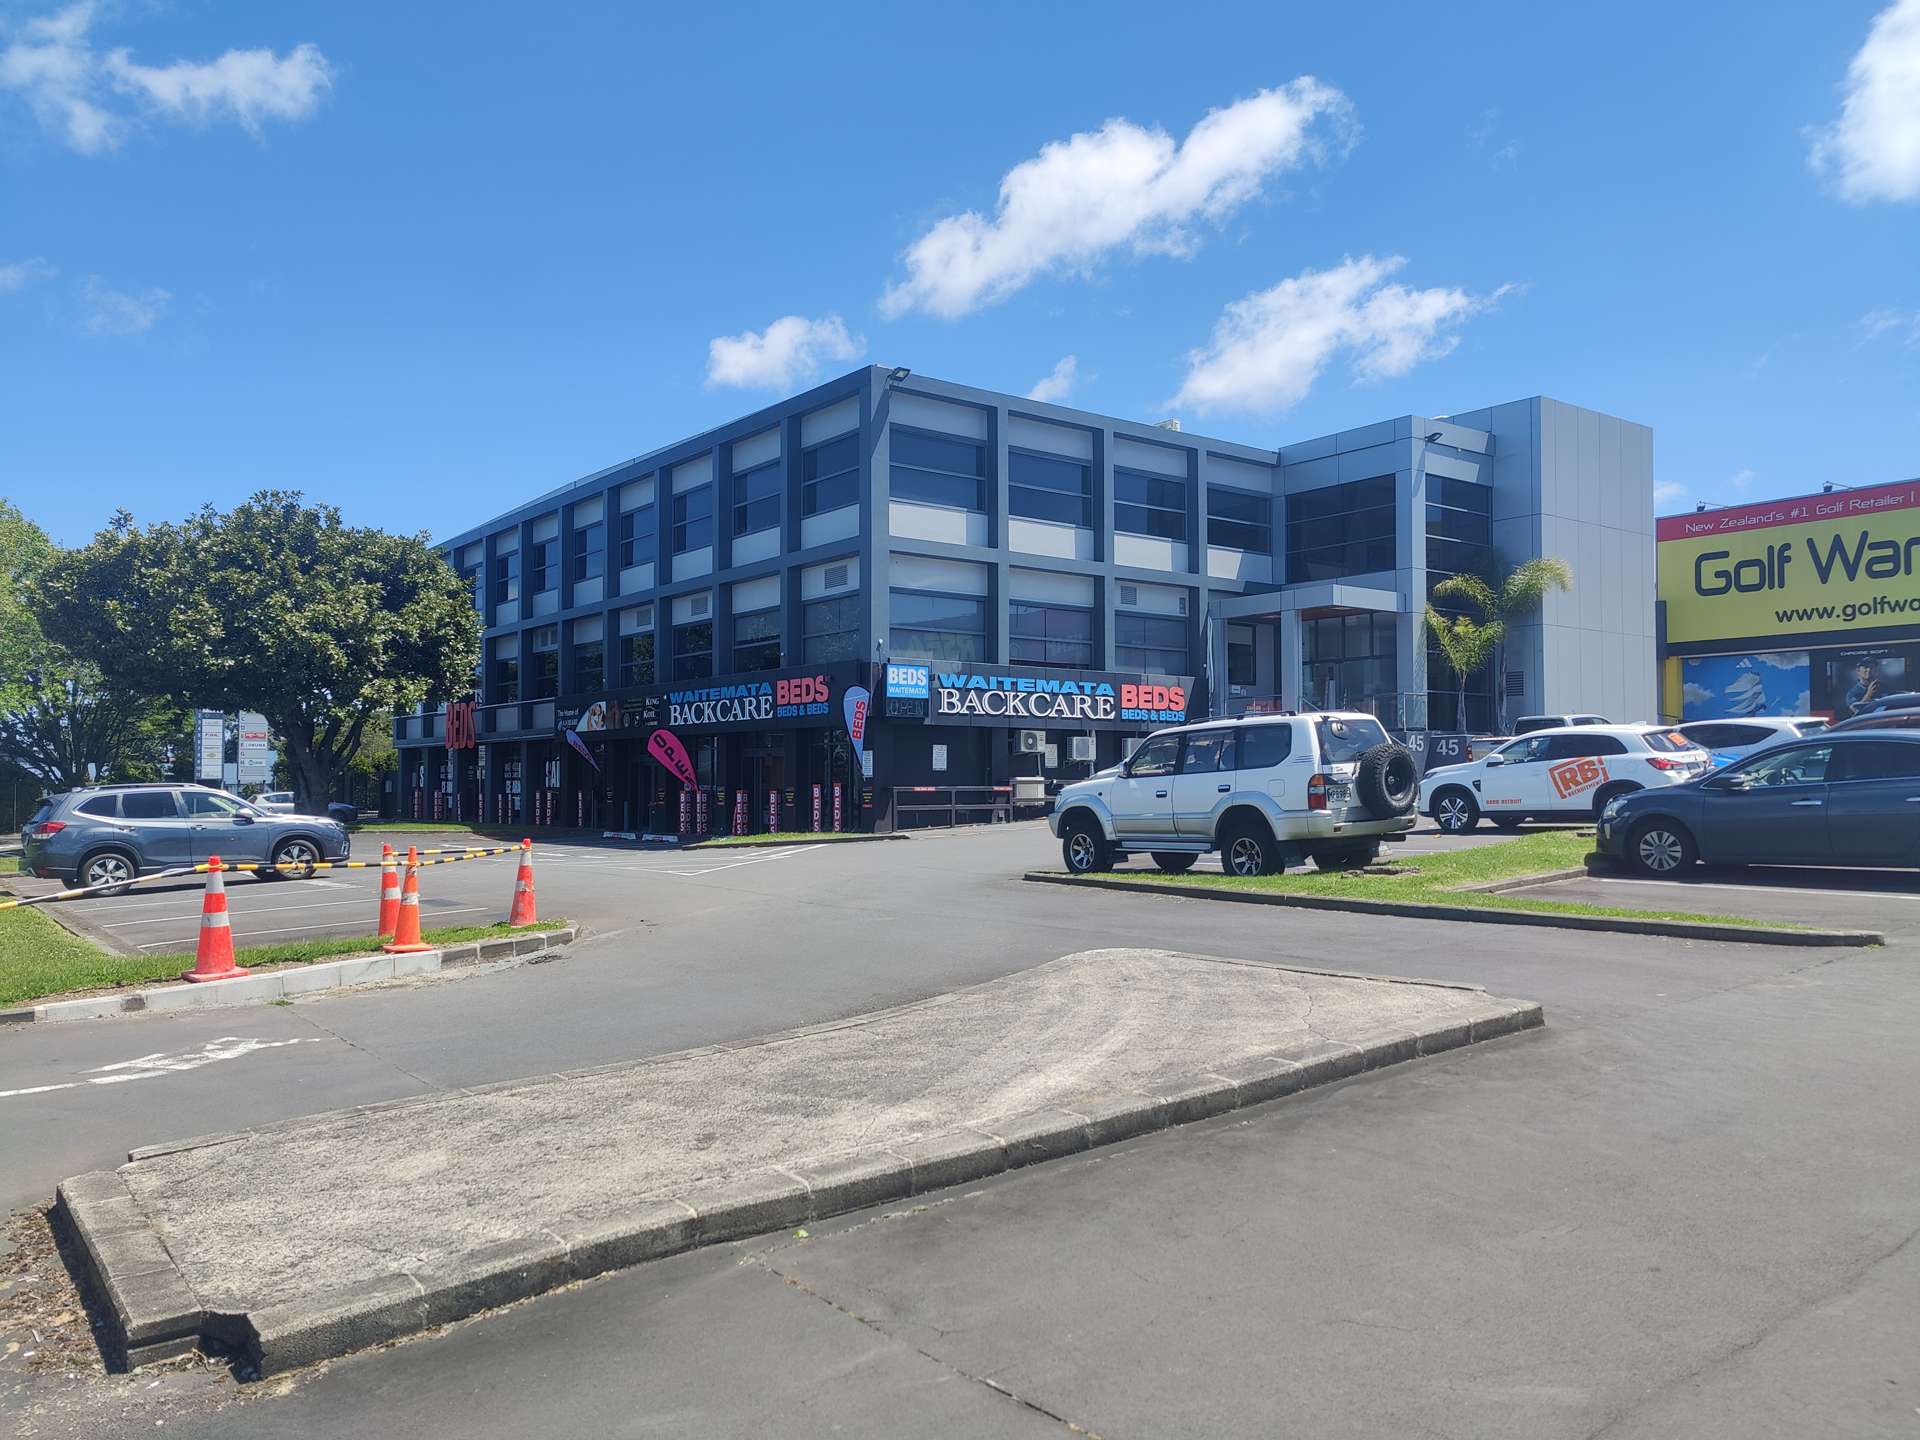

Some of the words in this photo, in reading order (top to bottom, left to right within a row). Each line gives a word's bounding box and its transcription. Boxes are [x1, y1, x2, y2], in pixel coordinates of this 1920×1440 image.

[1685, 520, 1714, 534] New
[1719, 510, 1785, 530] Zealand's
[1790, 506, 1809, 519] #1
[1816, 500, 1844, 516] Golf
[1849, 493, 1905, 511] Retailer
[1694, 542, 1792, 597] Golf
[888, 667, 927, 686] BEDS
[937, 673, 1116, 697] WAITEMATA
[645, 697, 660, 706] KING
[669, 682, 773, 704] WAITEMATA
[776, 674, 830, 706] BEDS
[888, 686, 927, 695] WAITEMATA
[1120, 683, 1186, 711] BEDS
[668, 695, 774, 726] BACKCARE
[777, 705, 798, 718] BEDS
[799, 705, 805, 716] &
[806, 703, 829, 715] BEDS
[937, 688, 1117, 720] BACKCARE
[1121, 709, 1148, 720] BEDS
[1150, 711, 1158, 721] &
[1159, 710, 1186, 722] BEDS
[445, 700, 476, 750] BEDS
[852, 700, 866, 740] BEDS
[1408, 734, 1424, 752] 45
[1436, 739, 1459, 756] 45
[833, 786, 841, 832] BEDS
